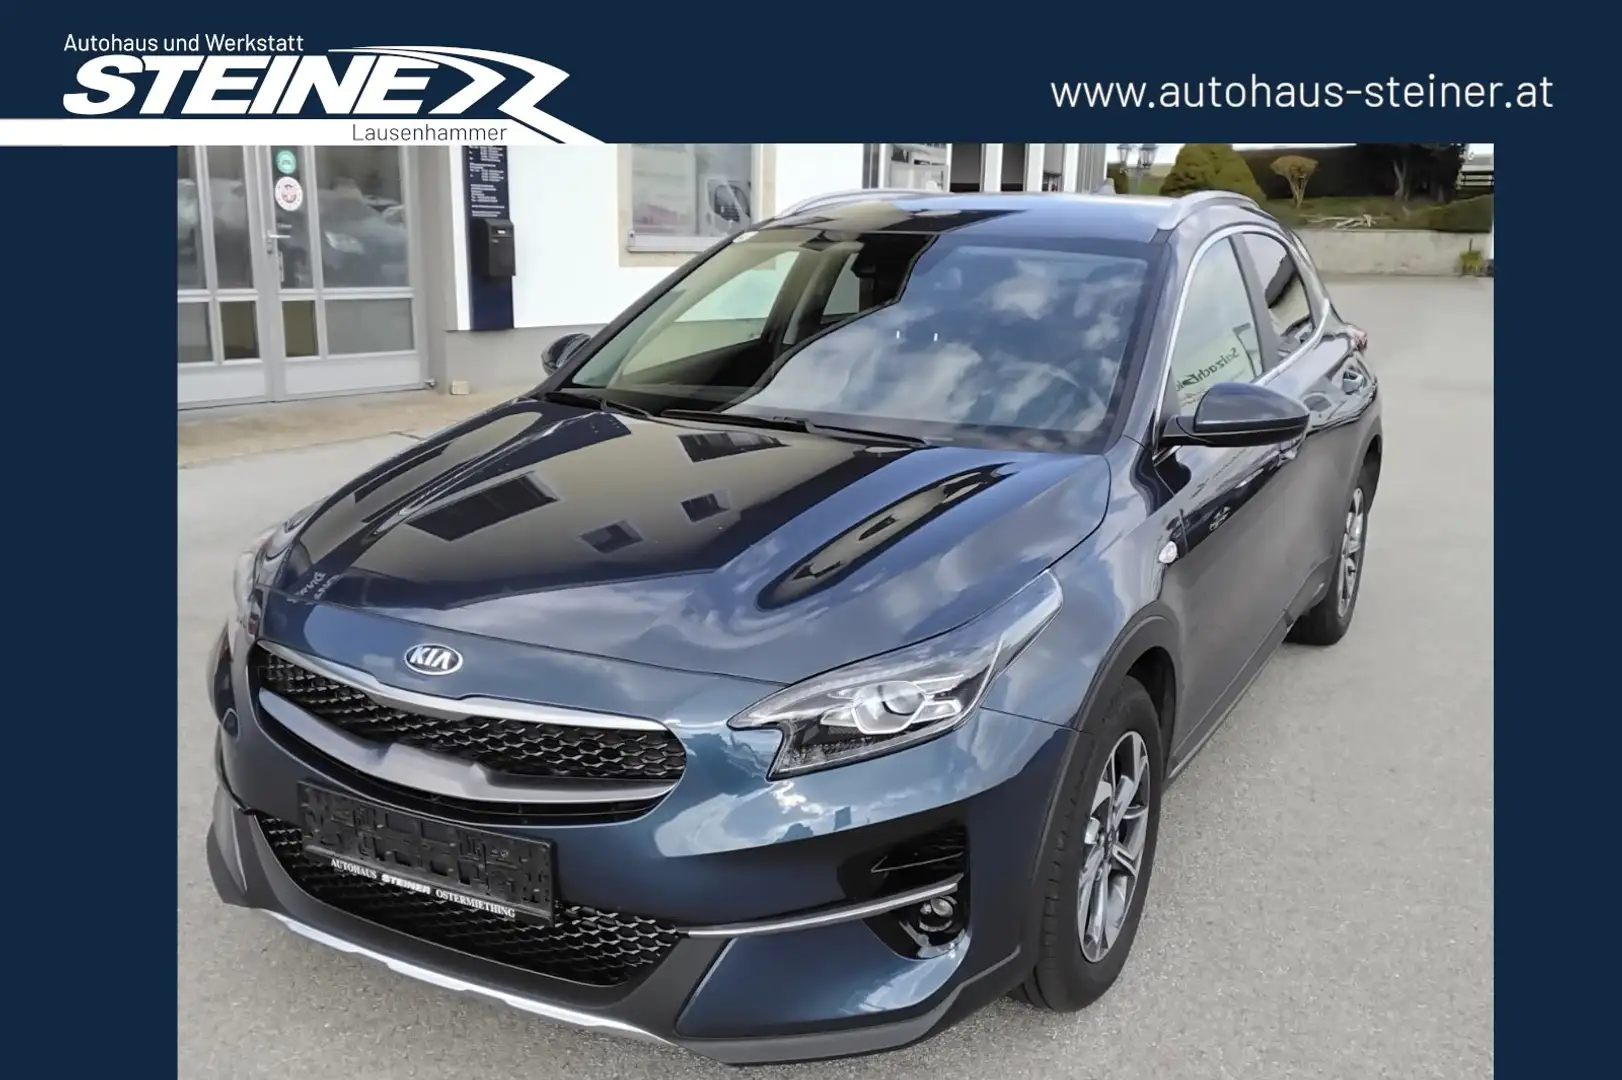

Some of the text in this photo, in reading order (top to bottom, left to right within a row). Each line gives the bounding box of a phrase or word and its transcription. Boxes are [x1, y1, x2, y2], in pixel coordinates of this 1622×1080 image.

[408, 646, 453, 671] KIA
[330, 857, 378, 880] AUTOHAUS
[435, 889, 516, 918] OSTERMIETHING
